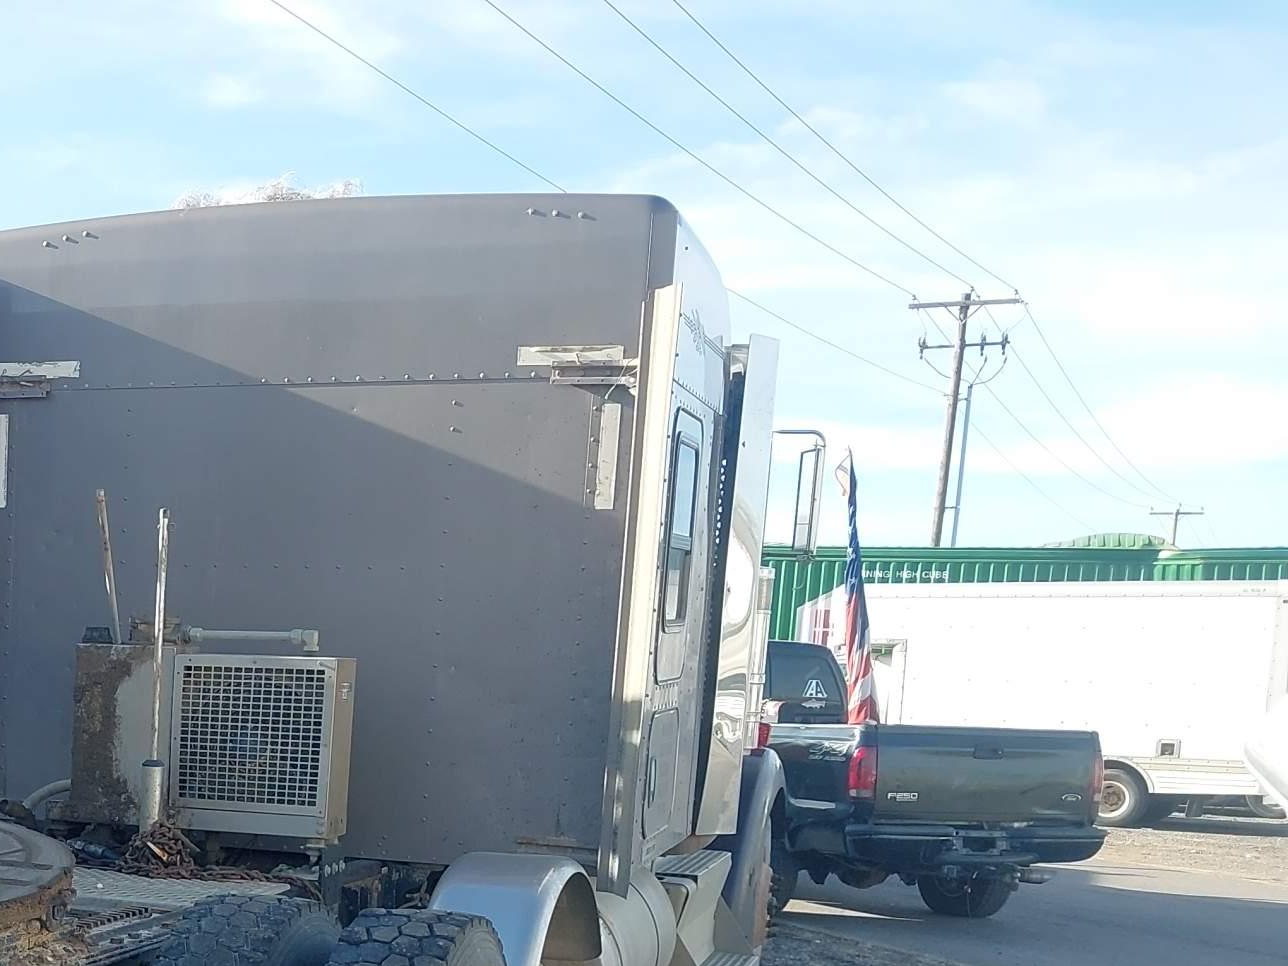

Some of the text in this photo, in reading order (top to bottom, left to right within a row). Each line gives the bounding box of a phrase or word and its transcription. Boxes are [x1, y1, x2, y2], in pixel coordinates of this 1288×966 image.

[863, 570, 948, 579] NING HIGH CUBE
